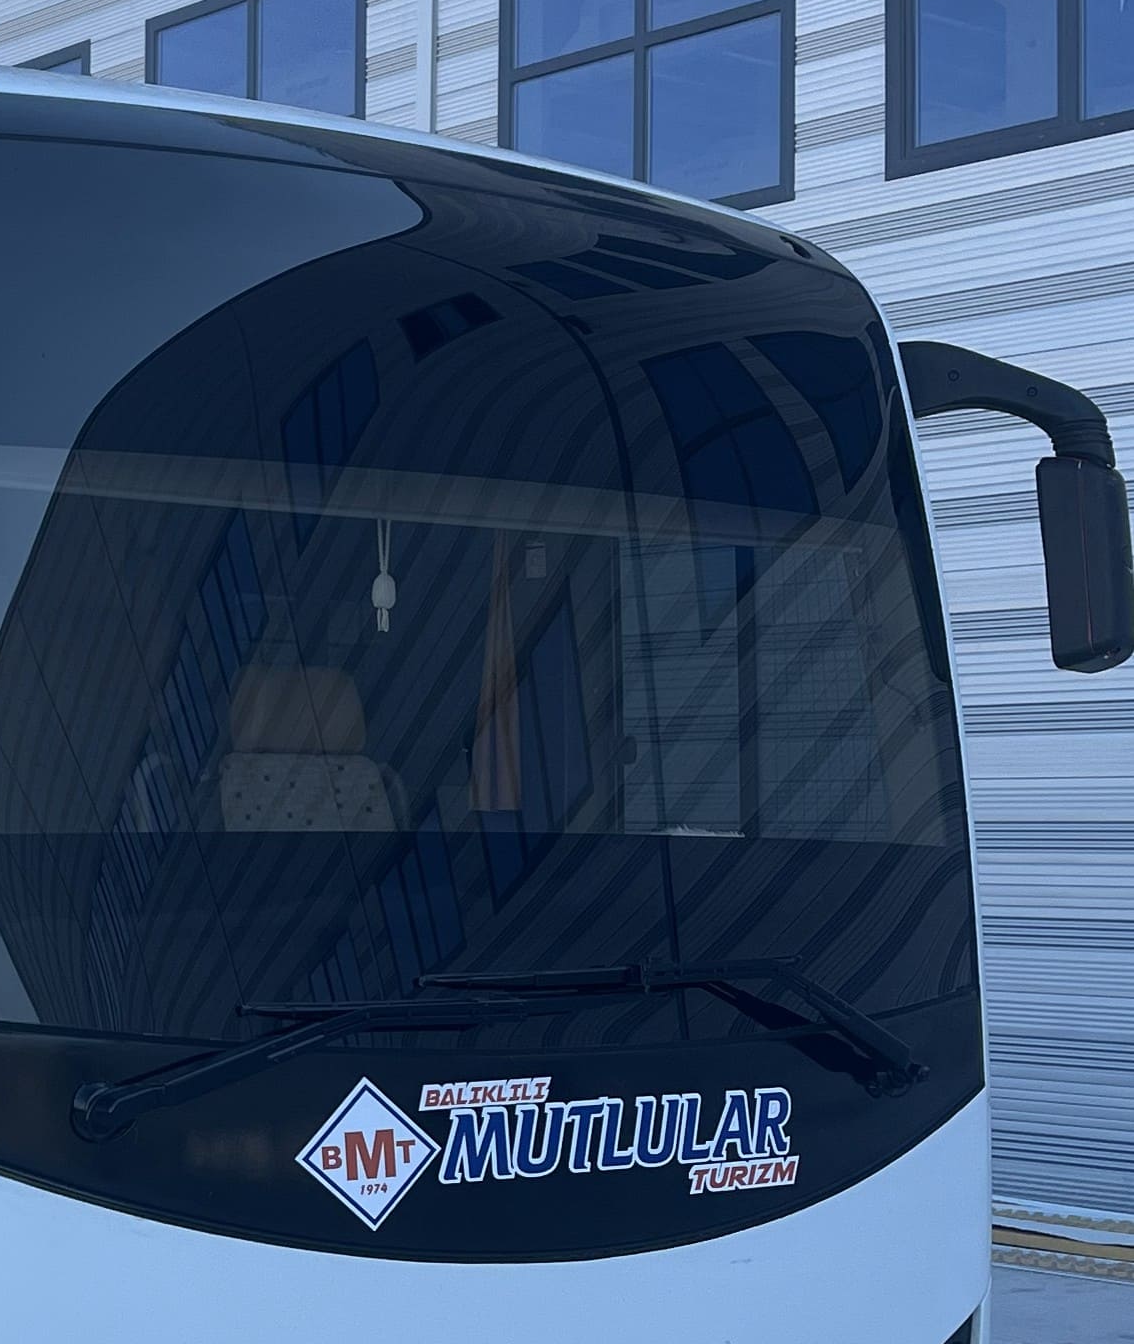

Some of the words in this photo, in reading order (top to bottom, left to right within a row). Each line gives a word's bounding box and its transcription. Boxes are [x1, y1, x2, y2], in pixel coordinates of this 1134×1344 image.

[322, 1129, 415, 1181] BMT
[443, 1088, 790, 1181] MUTLULAR
[360, 1183, 388, 1196] 1974
